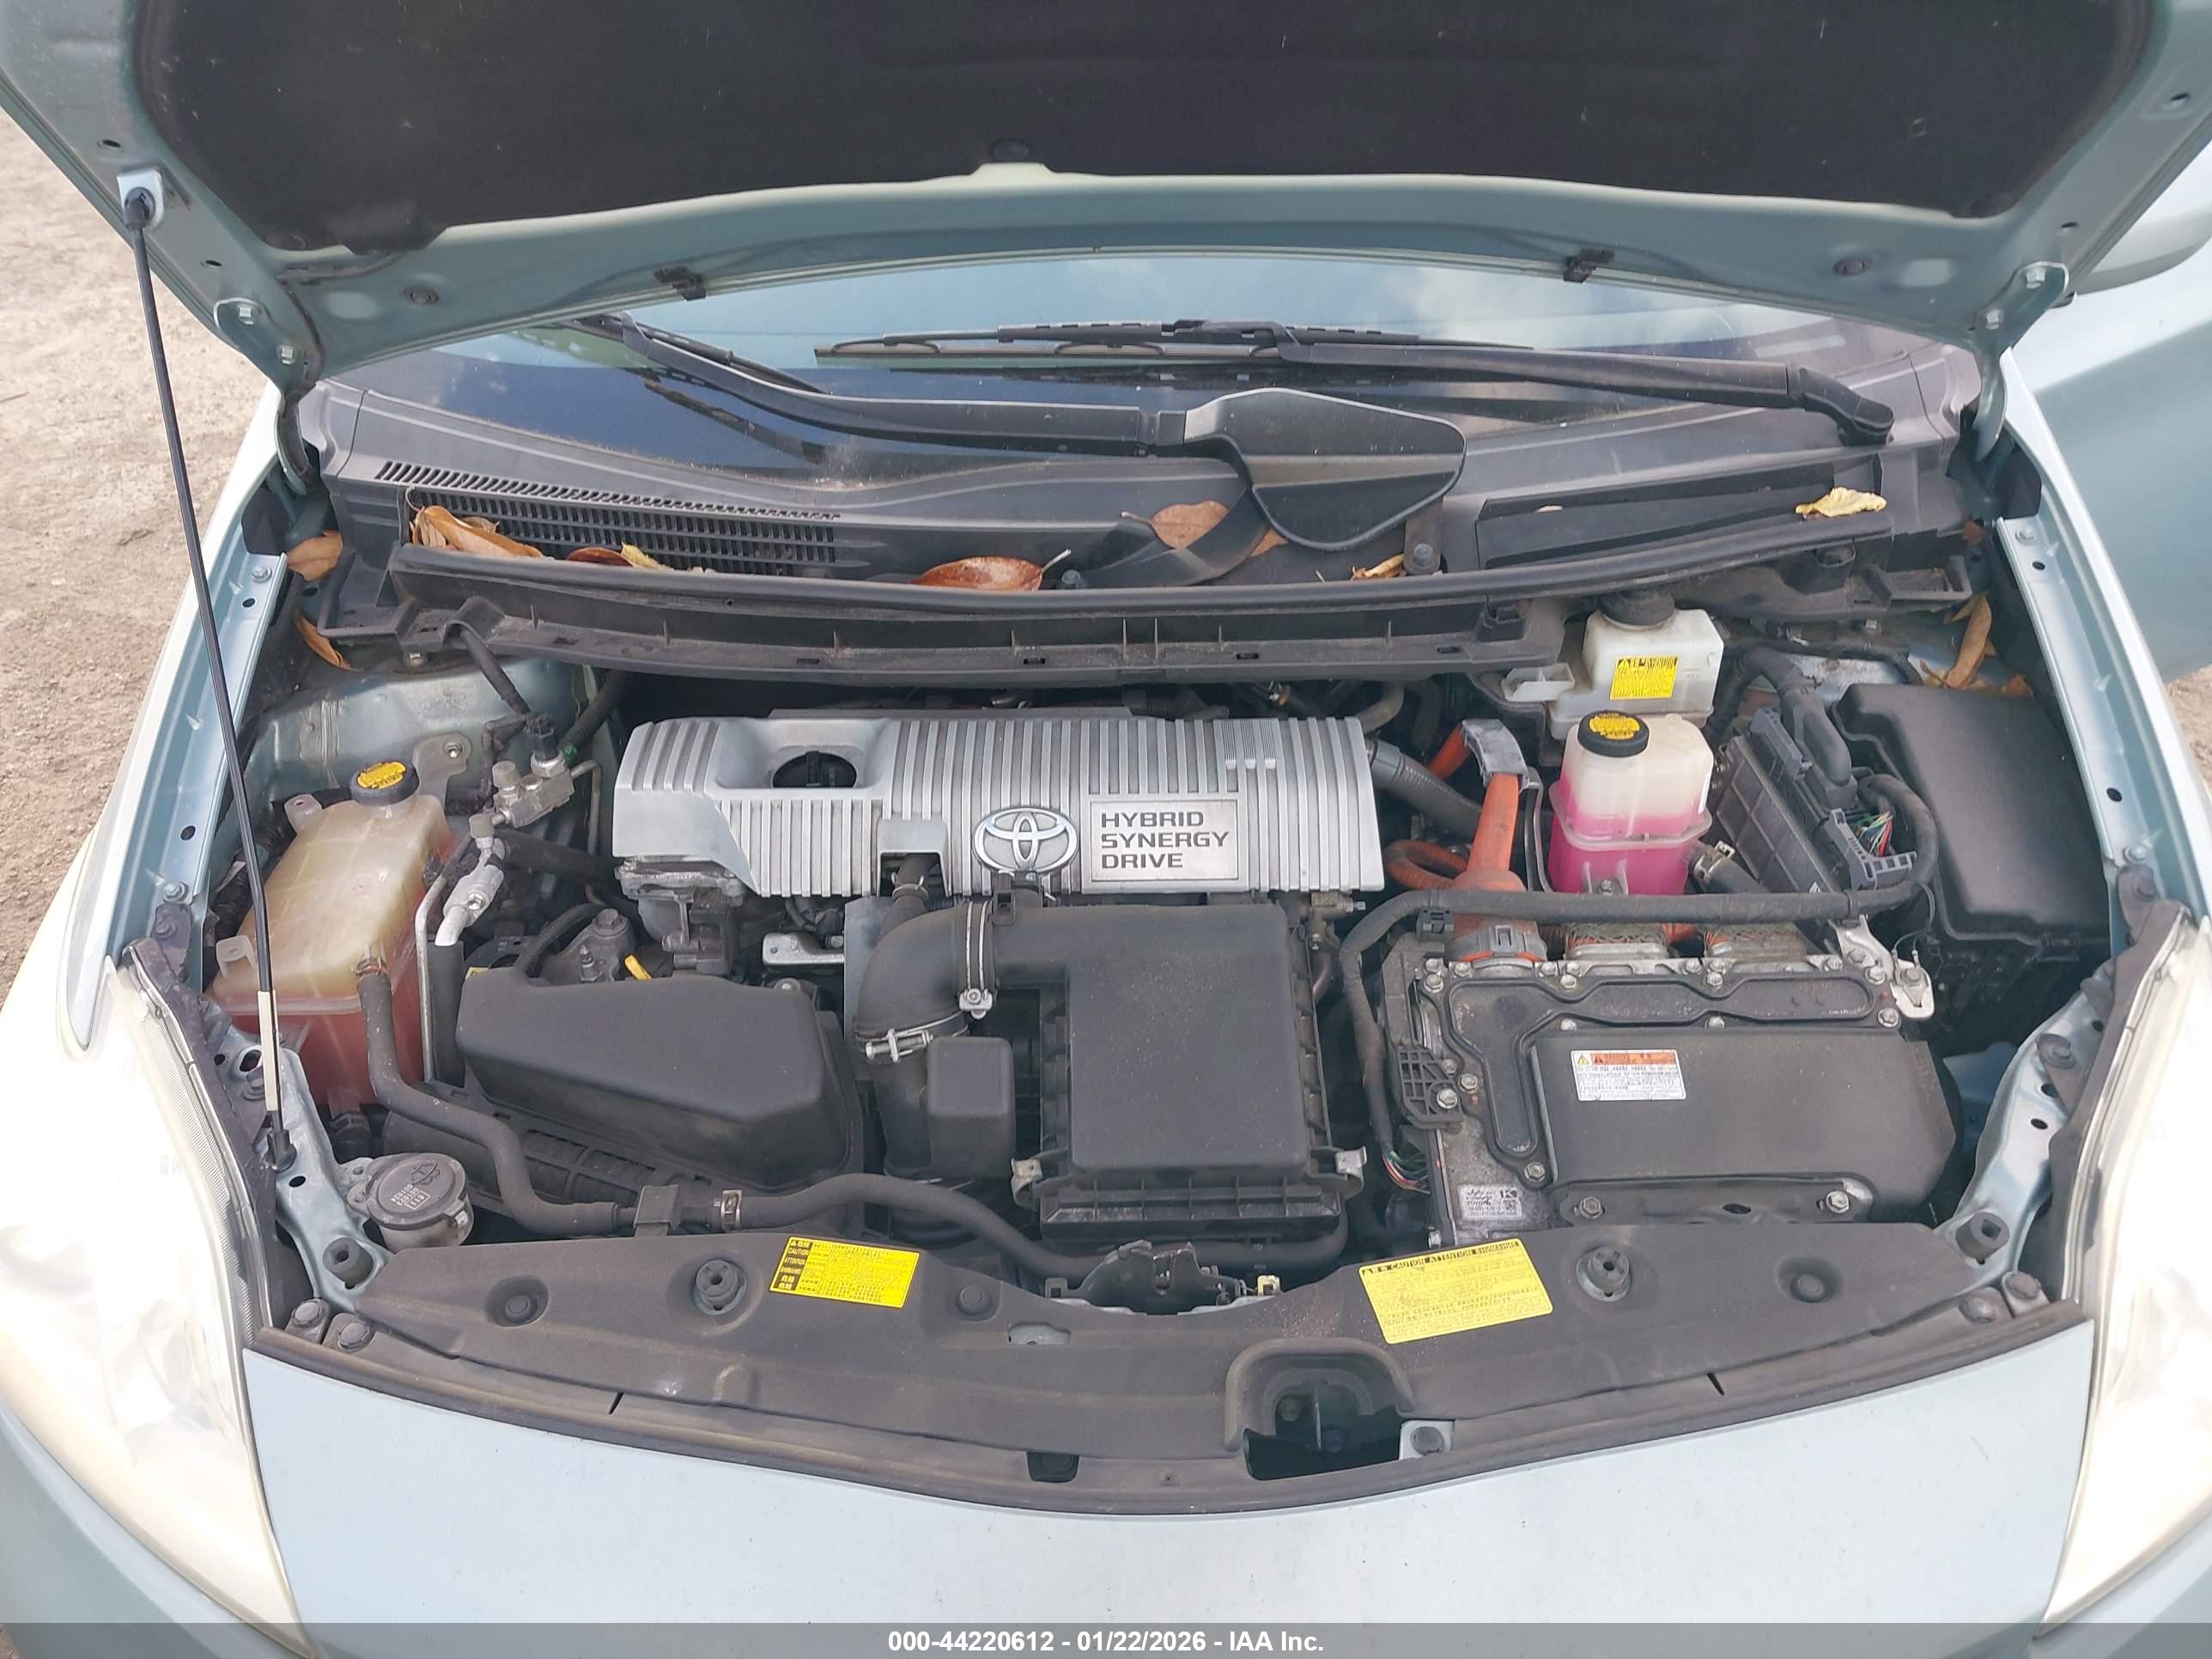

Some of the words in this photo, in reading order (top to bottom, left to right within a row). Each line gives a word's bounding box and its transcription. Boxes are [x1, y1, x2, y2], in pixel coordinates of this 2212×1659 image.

[1101, 811, 1204, 827] HYBRID
[1101, 832, 1230, 848] SYNERGY
[1101, 853, 1183, 869] DRIVE
[787, 1247, 810, 1256] CAUTION
